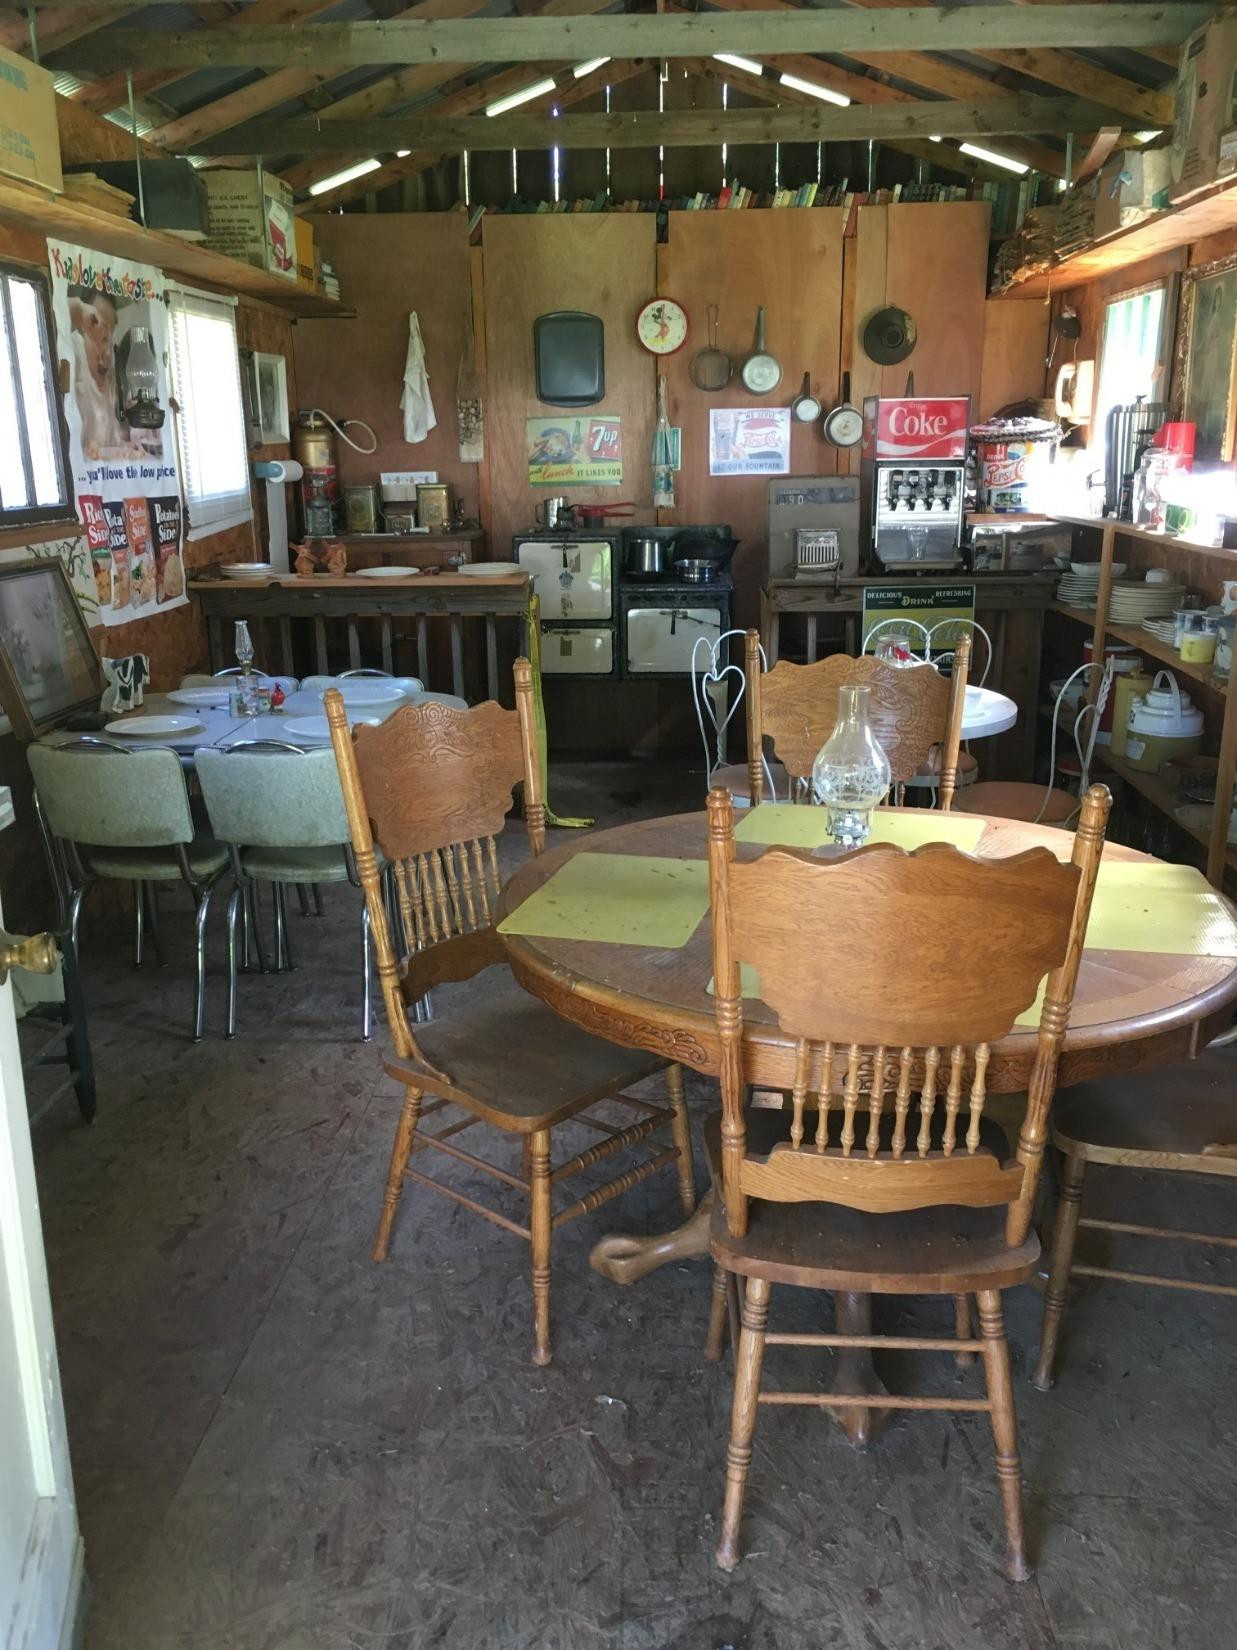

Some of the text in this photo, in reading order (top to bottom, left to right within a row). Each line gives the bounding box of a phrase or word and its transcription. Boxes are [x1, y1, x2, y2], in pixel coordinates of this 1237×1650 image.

[889, 406, 948, 437] Coke
[140, 465, 155, 478] low
[746, 463, 781, 472] FOUNTAIN
[867, 591, 902, 599] DELICIOUS
